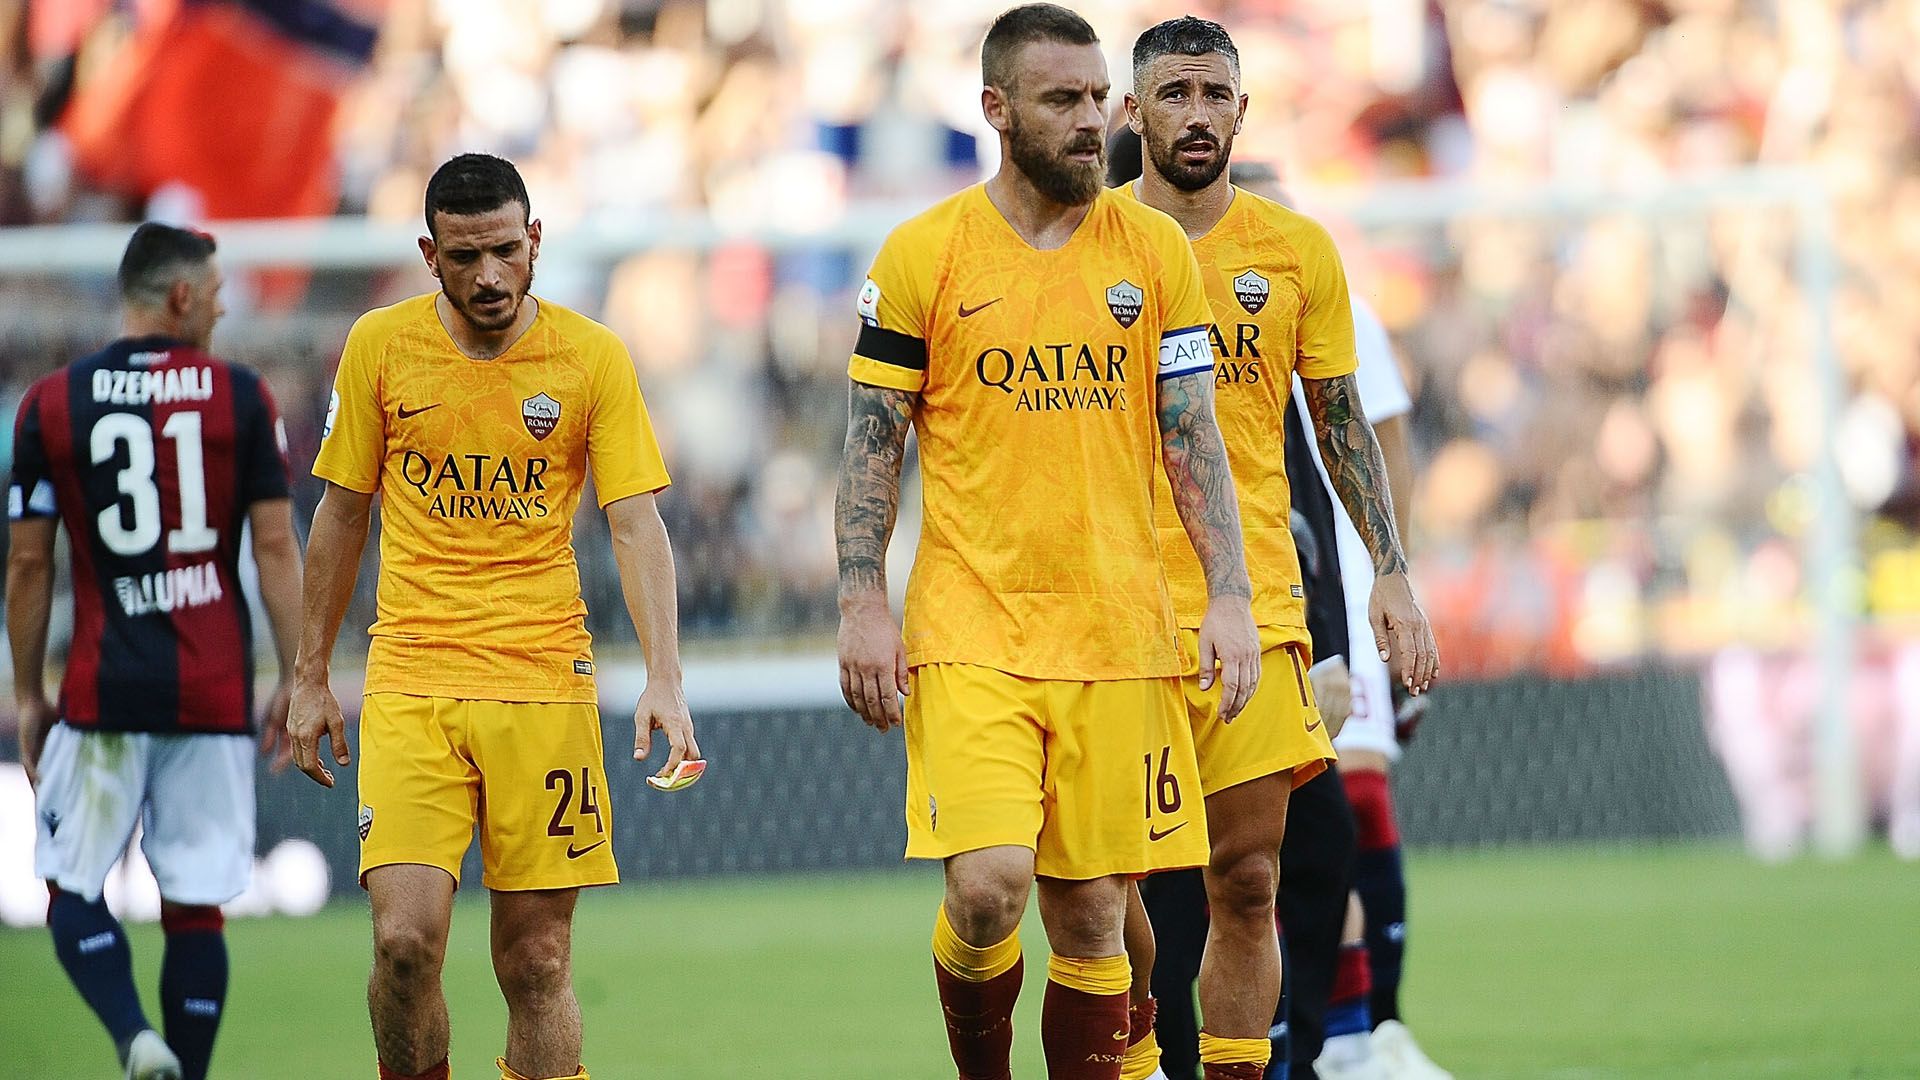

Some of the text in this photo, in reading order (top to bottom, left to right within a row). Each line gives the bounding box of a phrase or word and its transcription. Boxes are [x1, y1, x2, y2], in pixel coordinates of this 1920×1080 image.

[1112, 306, 1139, 316] ROMA
[1240, 294, 1265, 303] ROMA
[1208, 323, 1262, 358] AR
[976, 344, 1128, 394] QATAR
[1015, 386, 1127, 412] AIRWAYS
[527, 418, 554, 428] ROMA
[90, 411, 218, 556] 31
[402, 451, 549, 496] QATAR
[428, 494, 549, 520] AIRWAYS
[1144, 745, 1182, 820] 16
[544, 767, 604, 837] 24
